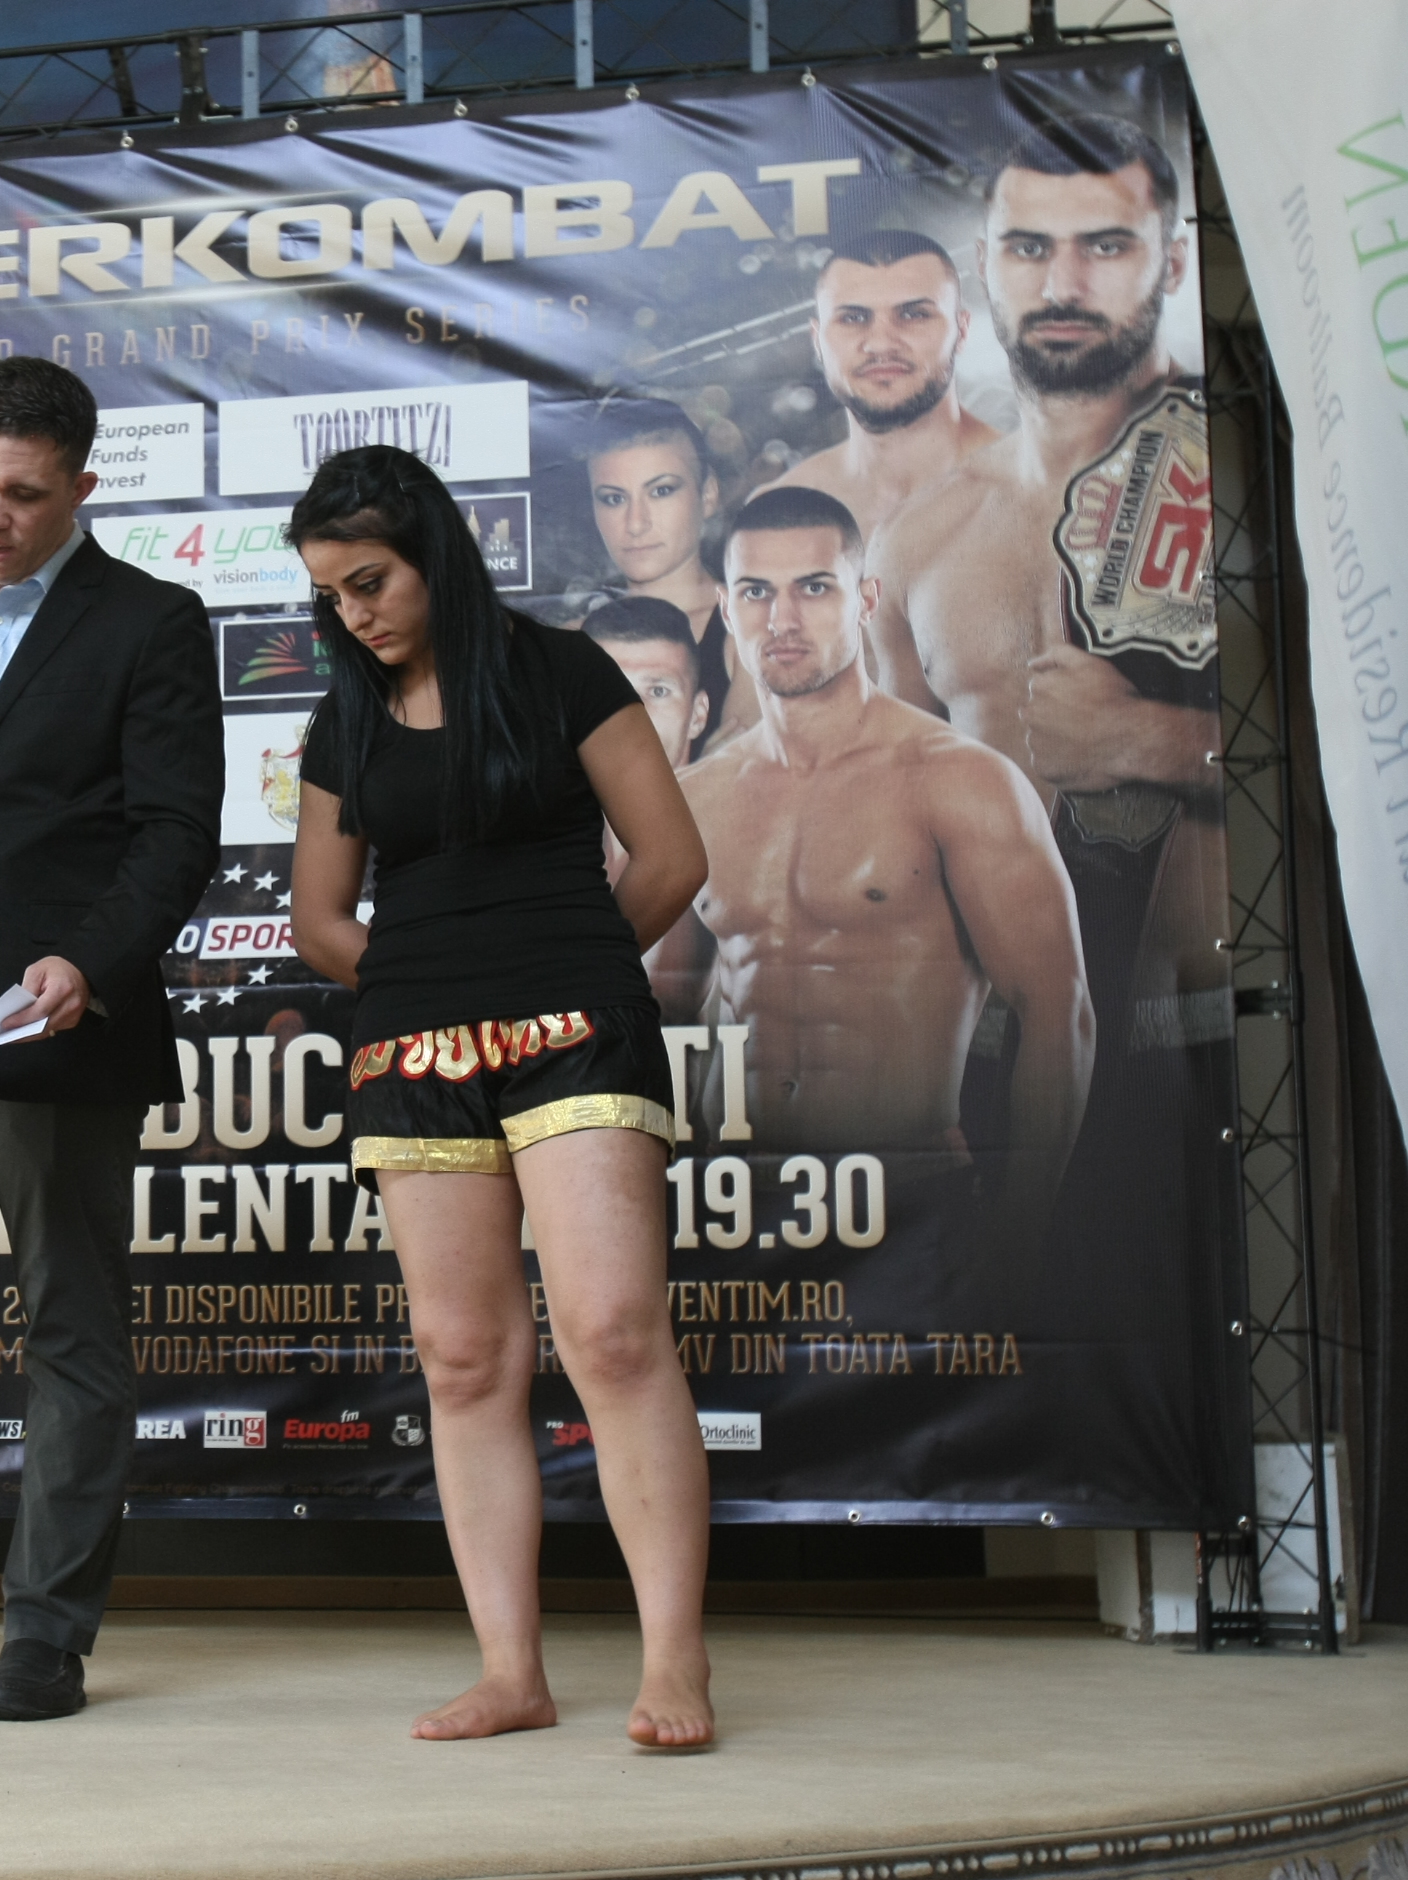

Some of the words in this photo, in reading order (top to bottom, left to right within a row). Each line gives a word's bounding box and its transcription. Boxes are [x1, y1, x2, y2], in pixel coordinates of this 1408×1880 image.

[52, 323, 212, 369] GRAND
[251, 311, 366, 355] PRIX
[406, 295, 590, 343] SERIES
[95, 422, 189, 441] European
[90, 445, 148, 465] Funds
[96, 472, 146, 489] nvest
[120, 525, 168, 561] fit
[174, 524, 205, 567] 4
[140, 1033, 344, 1150] BUC
[665, 1153, 886, 1250] 19.30
[165, 1284, 362, 1324] DISPONIBILE
[131, 1335, 296, 1375] VODAFONE
[310, 1335, 340, 1374] SI
[354, 1335, 385, 1374] IN
[730, 1334, 786, 1374] DIN
[801, 1333, 914, 1375] TOATA
[926, 1333, 1024, 1375] TARA
[205, 1412, 263, 1446] ring
[283, 1418, 371, 1442] Europa
